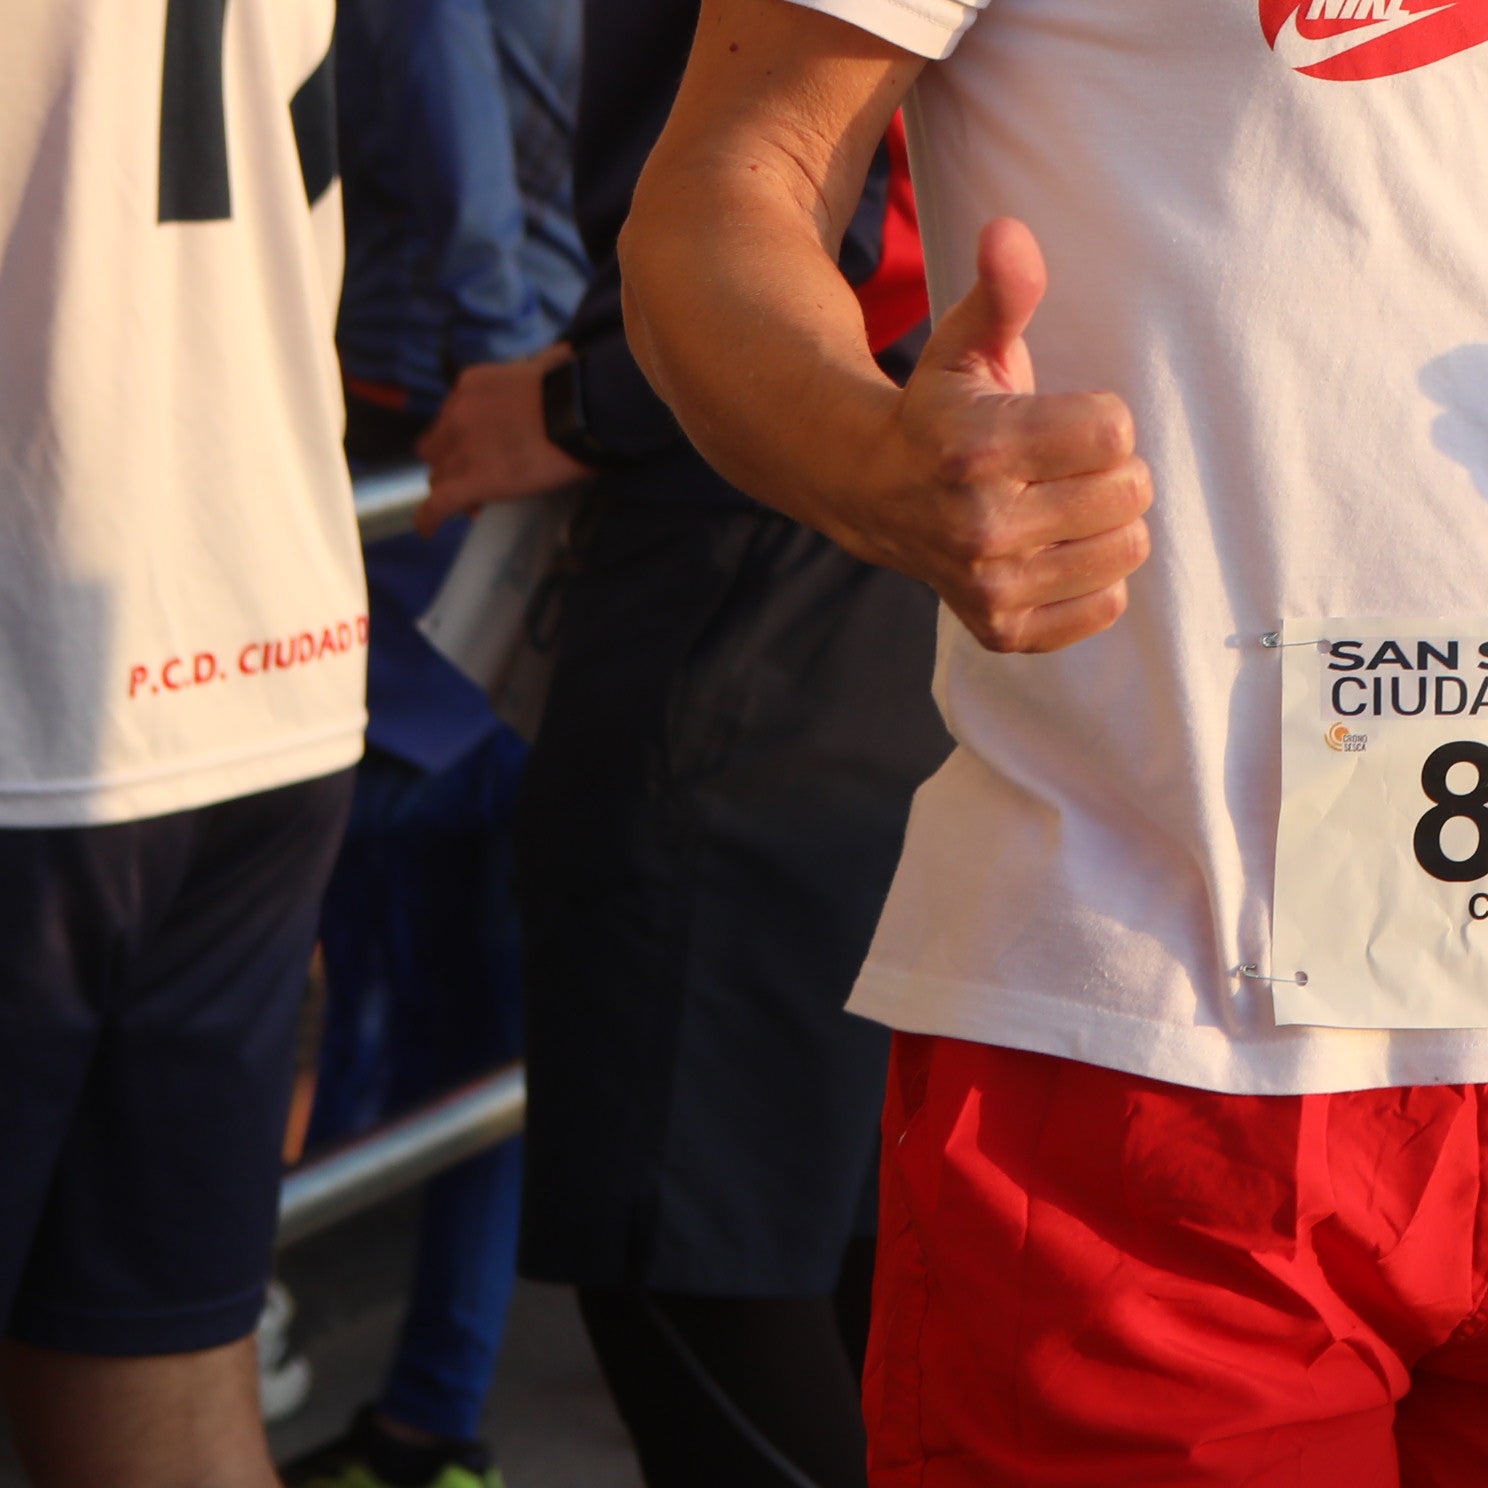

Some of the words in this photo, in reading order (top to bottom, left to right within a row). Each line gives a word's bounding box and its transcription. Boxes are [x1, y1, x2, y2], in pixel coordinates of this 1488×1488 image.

[128, 653, 227, 699] P.C.D.
[238, 622, 352, 675] CIUDAD
[1328, 640, 1458, 670] SAN
